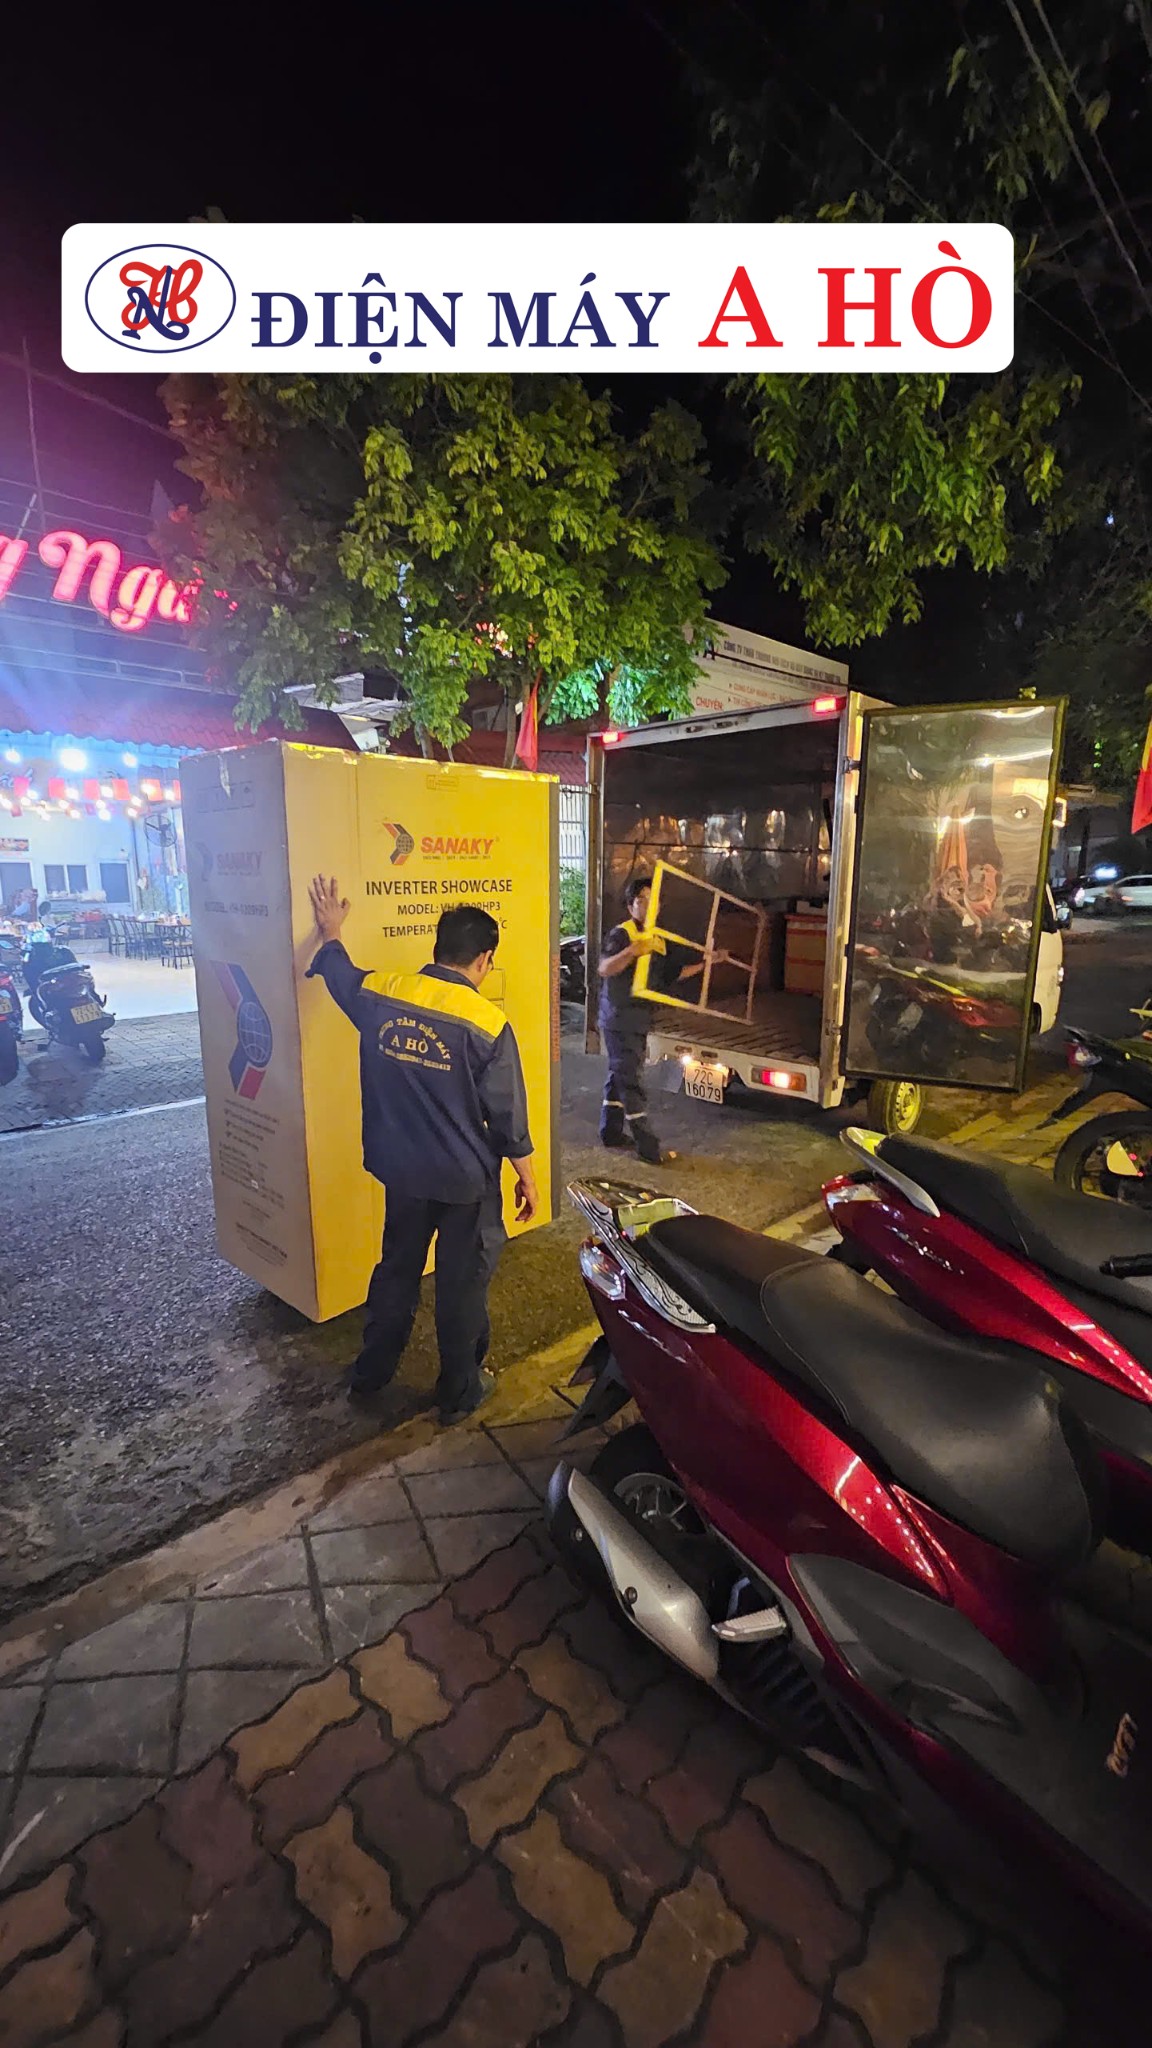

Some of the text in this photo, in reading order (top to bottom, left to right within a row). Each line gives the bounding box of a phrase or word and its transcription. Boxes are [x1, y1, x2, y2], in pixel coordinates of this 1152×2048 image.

[420, 836, 494, 855] SANAKY
[366, 879, 513, 896] INVERTER SHOWCASE
[397, 904, 439, 915] MODEL:
[383, 923, 439, 938] TEMPERAT
[391, 1034, 400, 1048] A
[693, 1068, 714, 1086] 72C
